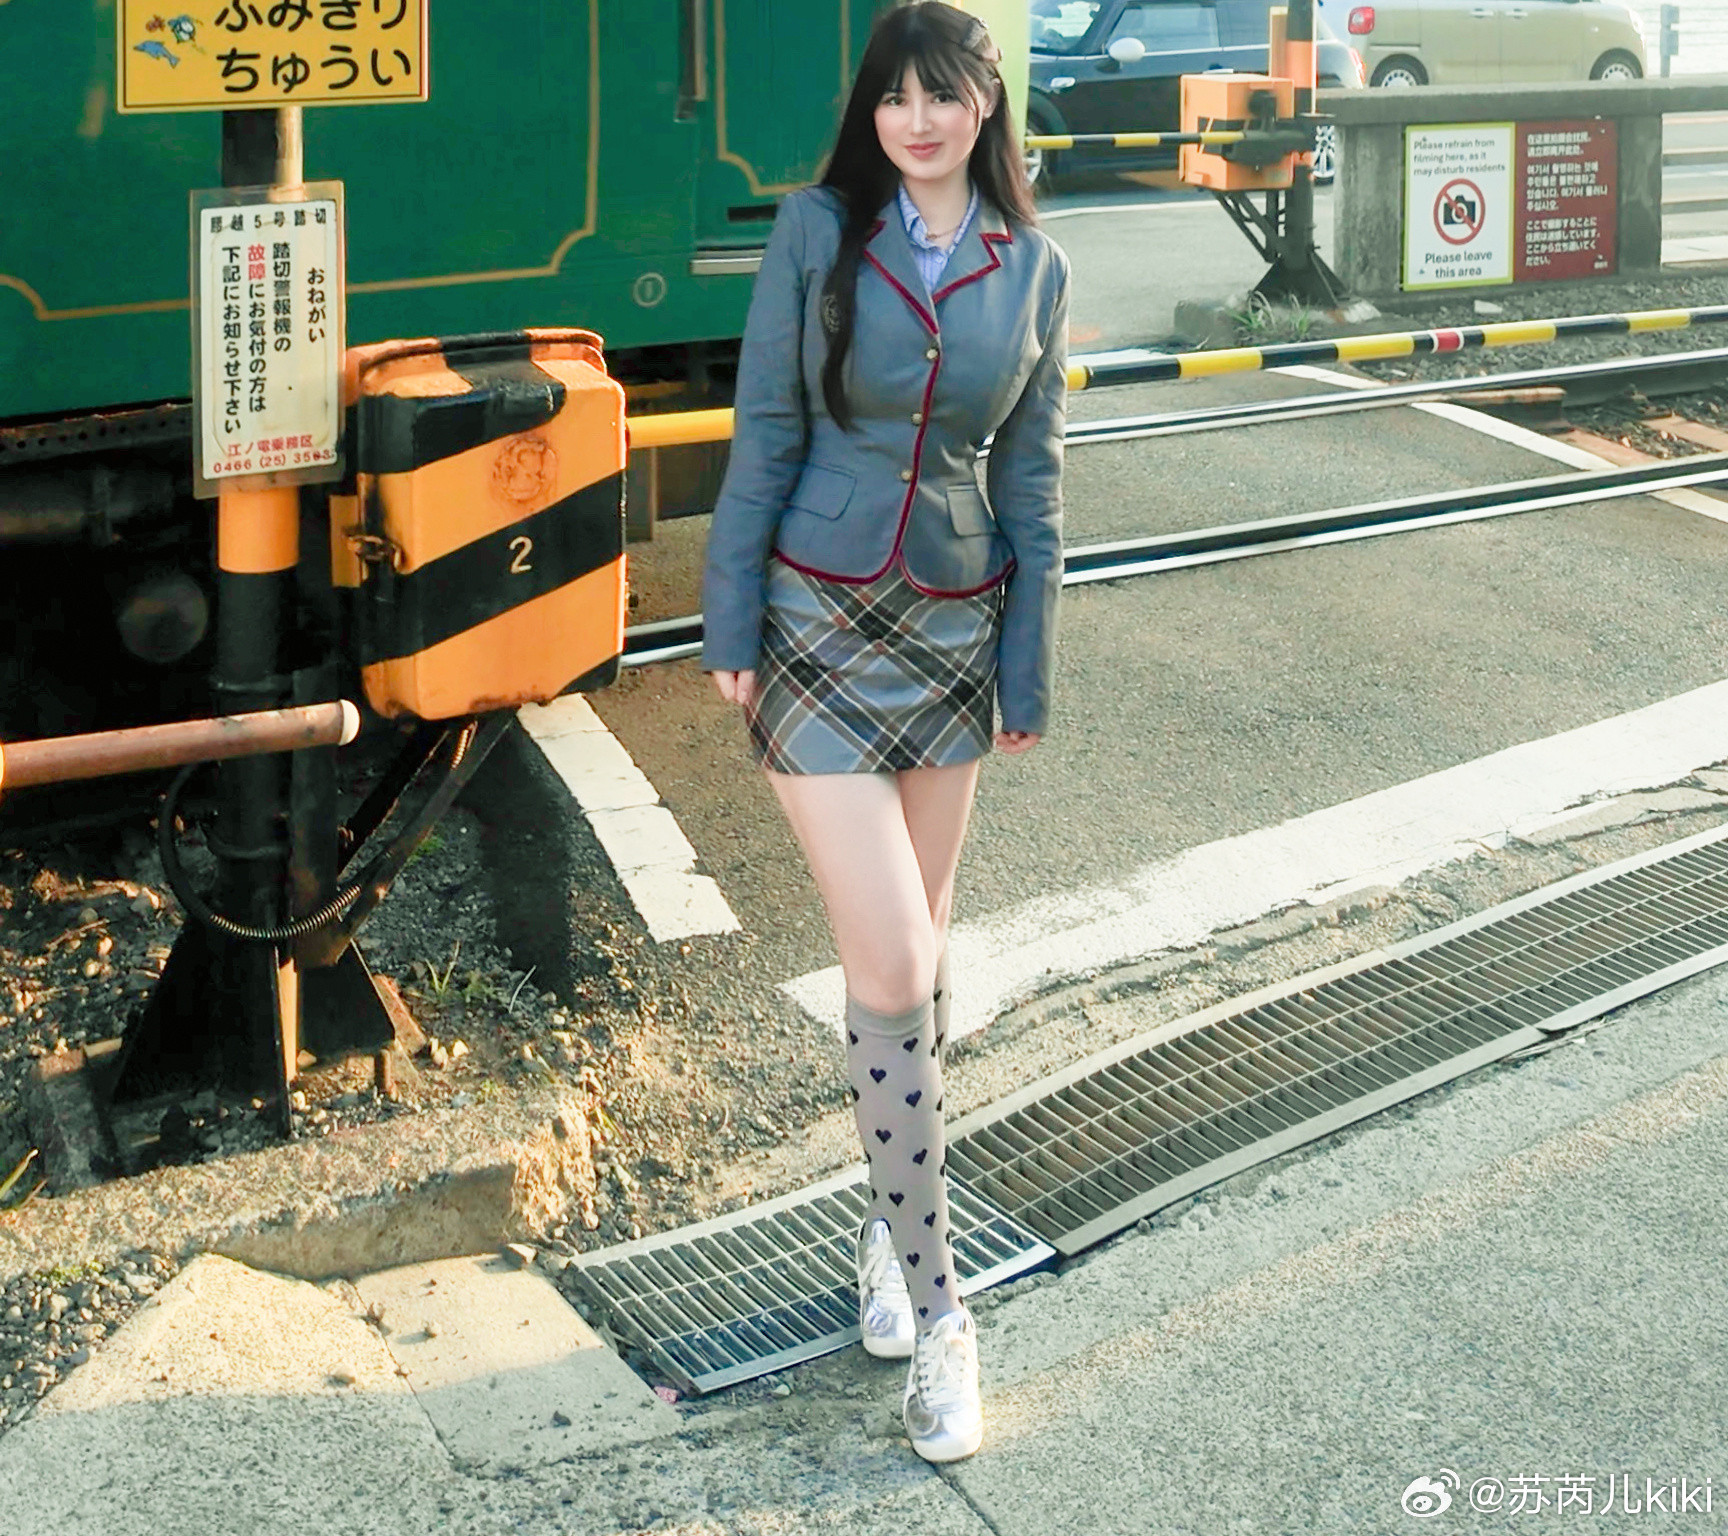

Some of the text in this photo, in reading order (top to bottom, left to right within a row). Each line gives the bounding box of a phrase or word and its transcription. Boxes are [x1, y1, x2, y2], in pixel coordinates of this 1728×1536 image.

[217, 45, 412, 94] ちゅうい
[1414, 138, 1495, 150] Please refrain from
[1414, 153, 1443, 163] filming
[1445, 153, 1467, 162] here,
[1414, 163, 1505, 177] may disturb residents
[1425, 249, 1492, 264] Please leave
[1435, 266, 1482, 278] this area
[272, 242, 291, 352] 踏切警報機の
[307, 267, 326, 343] おねがい
[222, 246, 242, 434] 下記にお知らせ下さい
[247, 244, 267, 413] 故障にお気付の方は
[213, 459, 252, 474] 0466
[259, 453, 286, 468] (25)
[508, 536, 533, 574] 2
